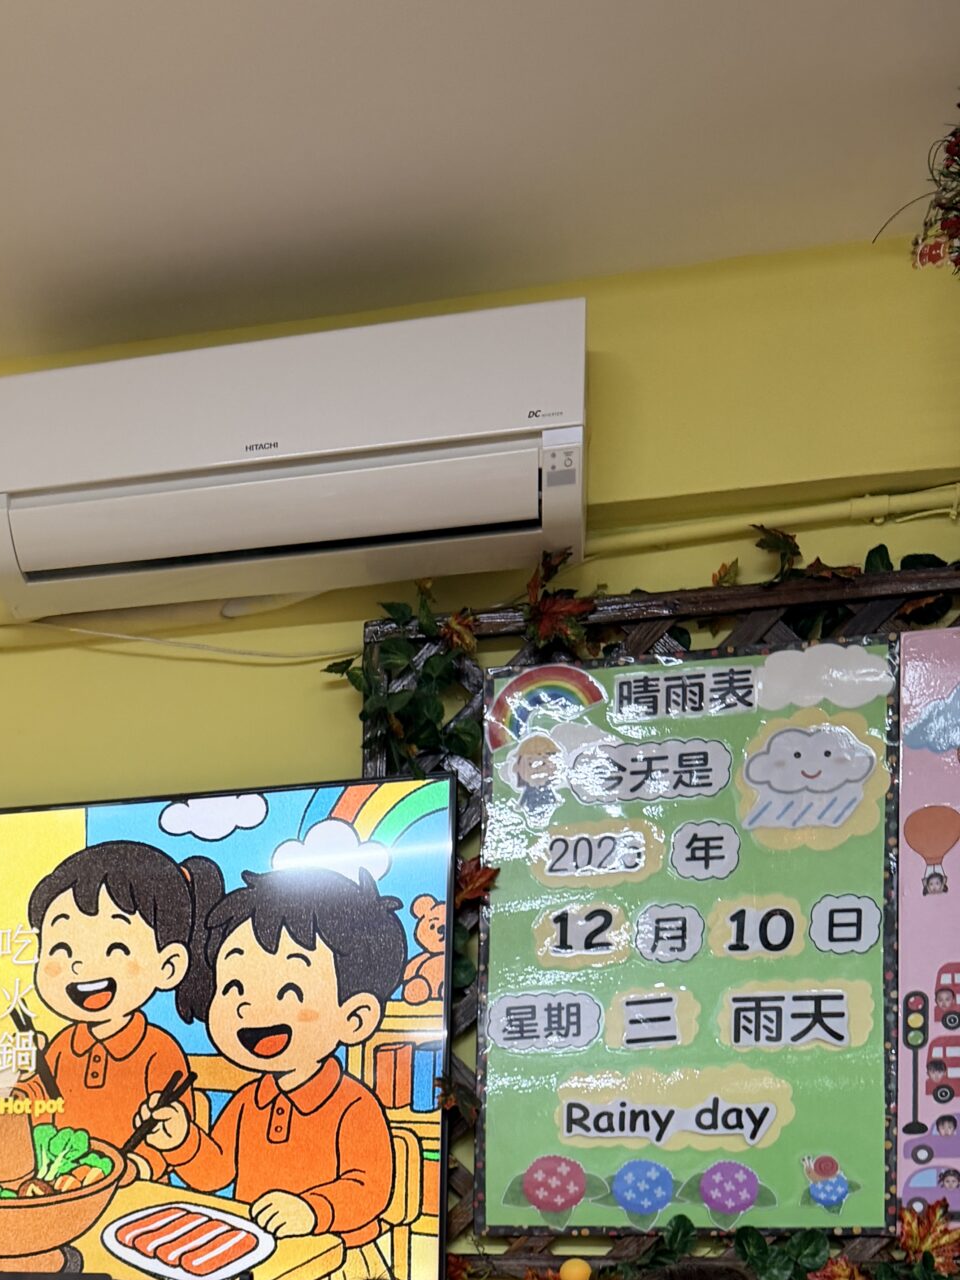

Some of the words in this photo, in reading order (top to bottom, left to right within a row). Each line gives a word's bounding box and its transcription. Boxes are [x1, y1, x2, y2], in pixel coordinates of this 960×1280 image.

[528, 410, 541, 418] DC
[245, 442, 279, 452] HITACHI
[618, 669, 754, 715] 晴雨表
[594, 751, 713, 793] 今天是
[686, 833, 725, 870] 年
[552, 908, 613, 951] 12
[650, 916, 688, 953] 月
[727, 908, 796, 952] 10
[828, 907, 863, 943] 日
[502, 1002, 581, 1041] 星期
[625, 997, 677, 1045] 三
[732, 994, 845, 1044] 雨天
[0, 1096, 32, 1115] Hot
[34, 1097, 65, 1118] pot
[565, 1101, 675, 1142] Rainy
[694, 1096, 770, 1141] day
